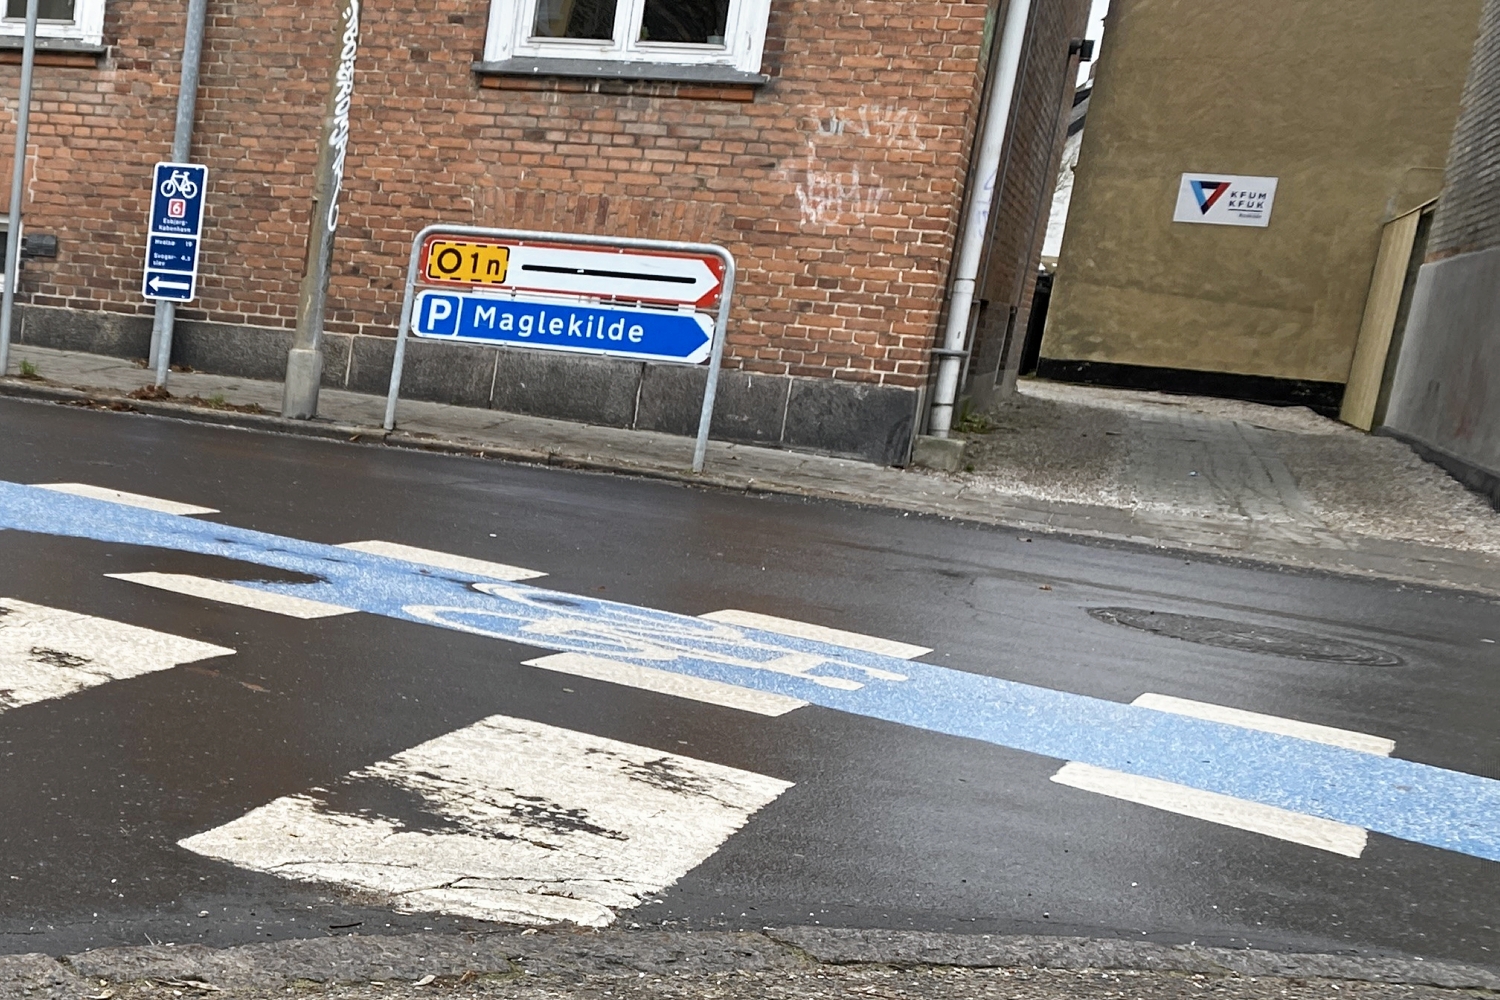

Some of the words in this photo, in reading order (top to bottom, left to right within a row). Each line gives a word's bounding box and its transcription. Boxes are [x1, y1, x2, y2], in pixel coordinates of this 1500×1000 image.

[1230, 191, 1267, 200] KFUM
[172, 202, 182, 215] 6
[1228, 200, 1265, 209] KFUK
[426, 298, 452, 331] P
[473, 304, 644, 343] Maglekilde
